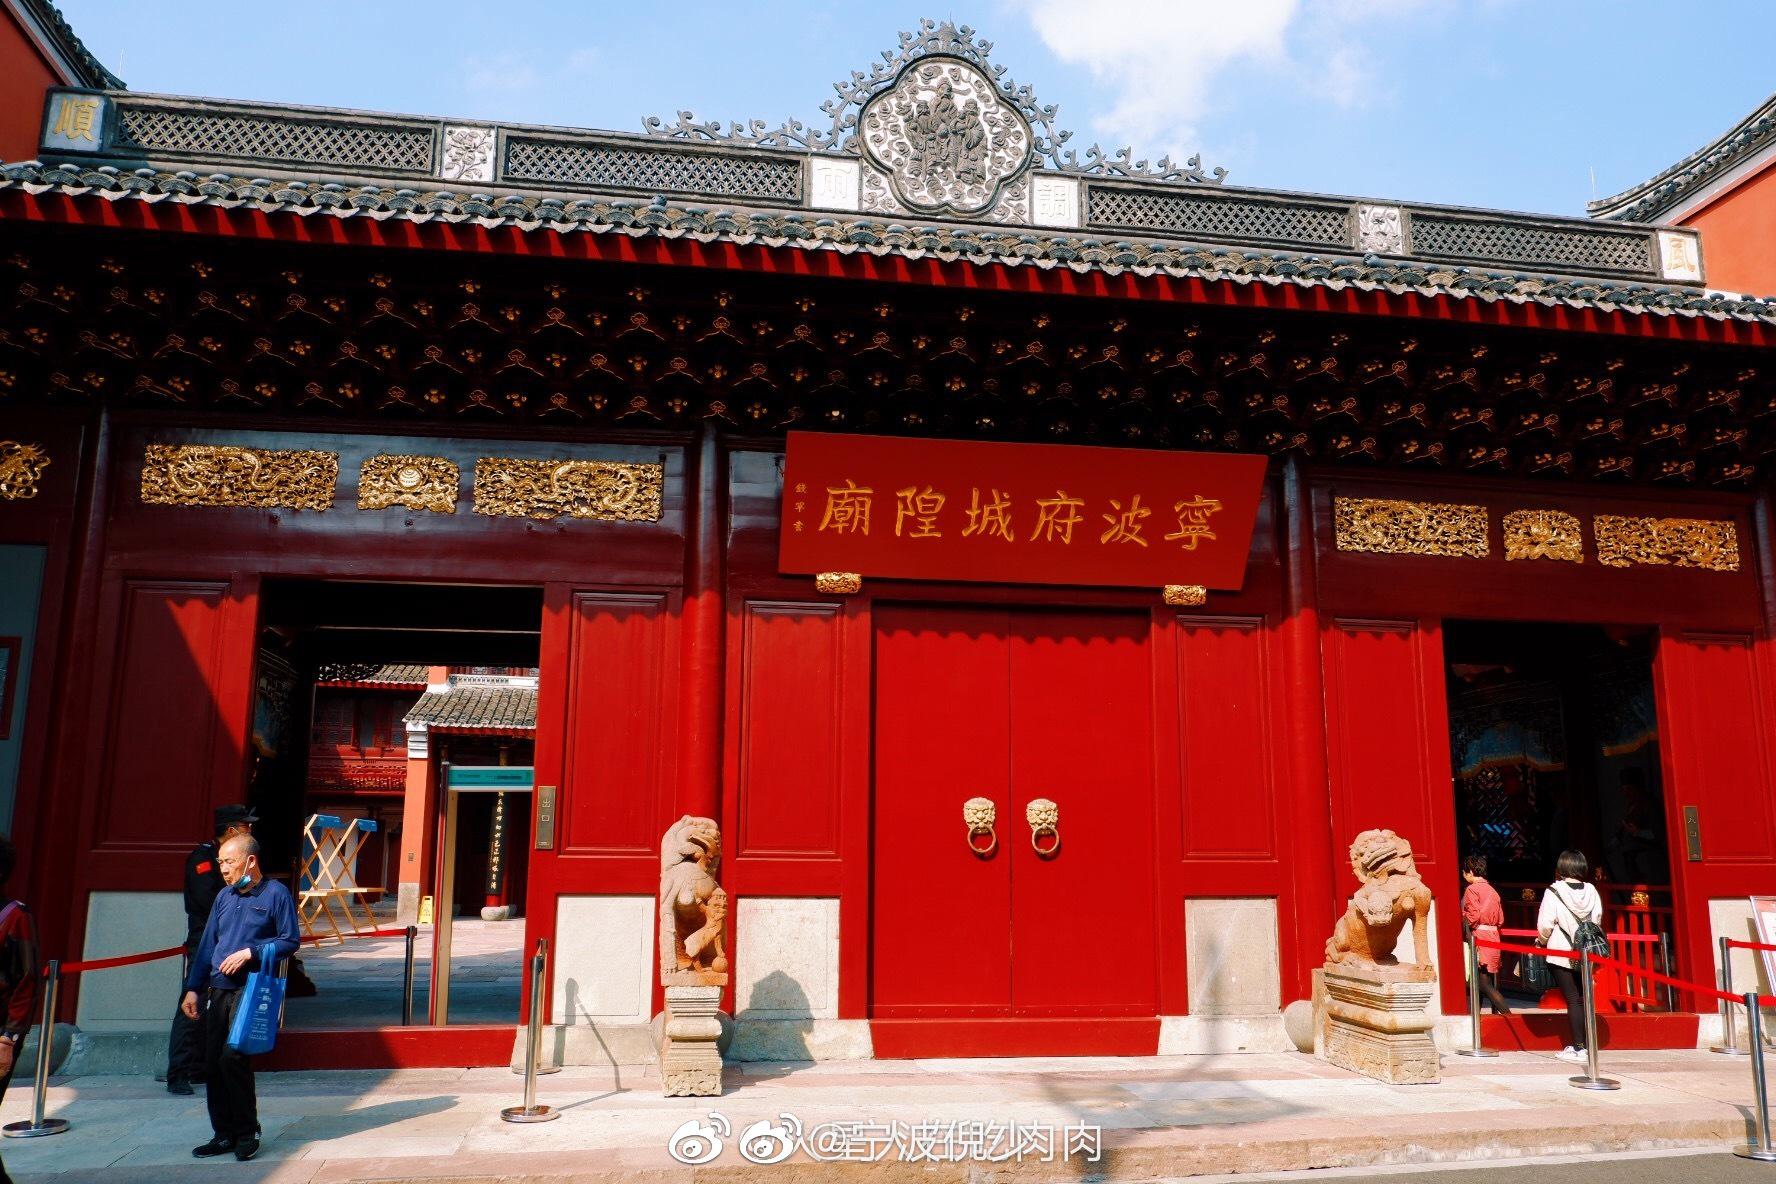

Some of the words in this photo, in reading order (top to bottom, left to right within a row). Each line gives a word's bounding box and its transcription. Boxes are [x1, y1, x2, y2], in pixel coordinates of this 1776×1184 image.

[53, 96, 99, 141] 順
[1666, 236, 1696, 272] 風
[541, 798, 552, 822] 出口
